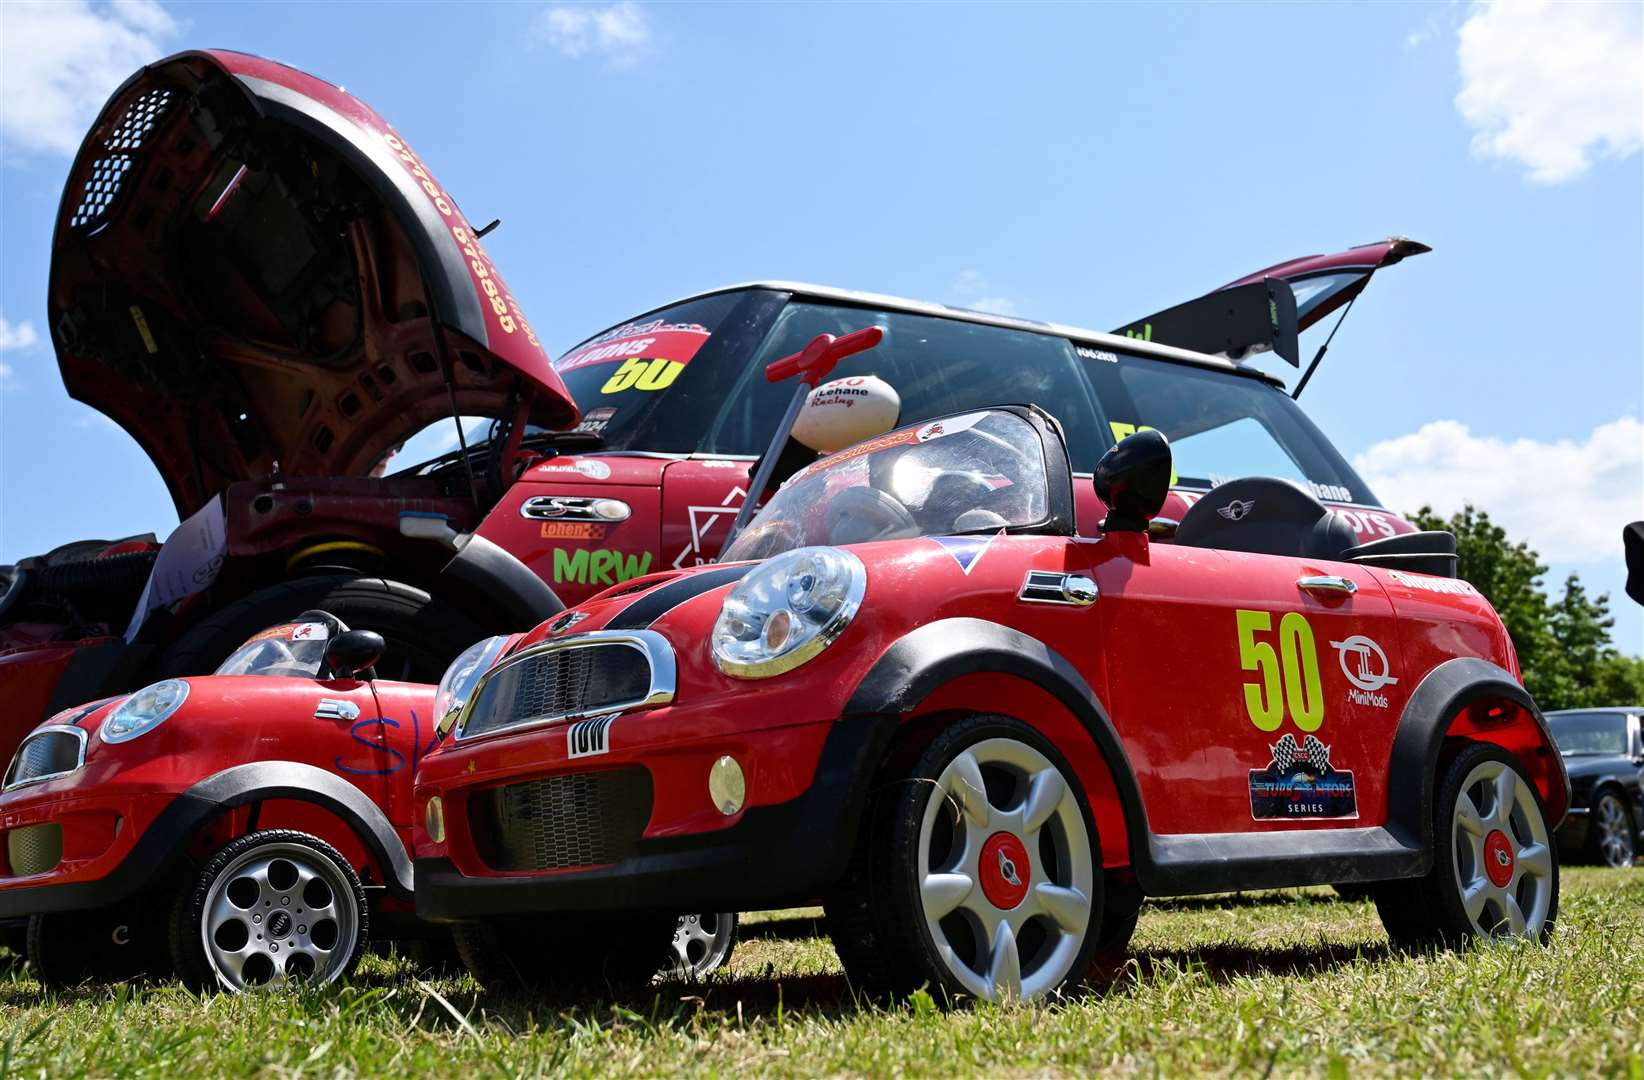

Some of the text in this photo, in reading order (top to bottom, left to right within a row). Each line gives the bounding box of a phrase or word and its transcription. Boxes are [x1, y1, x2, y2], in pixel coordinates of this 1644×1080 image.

[384, 132, 452, 216] 07780
[452, 226, 517, 334] 573825
[601, 357, 686, 394] 50
[811, 396, 855, 408] Racing
[1307, 479, 1352, 503] hane
[553, 548, 653, 586] MRW
[1236, 609, 1324, 732] 50
[1347, 689, 1388, 709] MiniMods
[1287, 803, 1324, 813] SERIES
[271, 913, 288, 936] MINI
